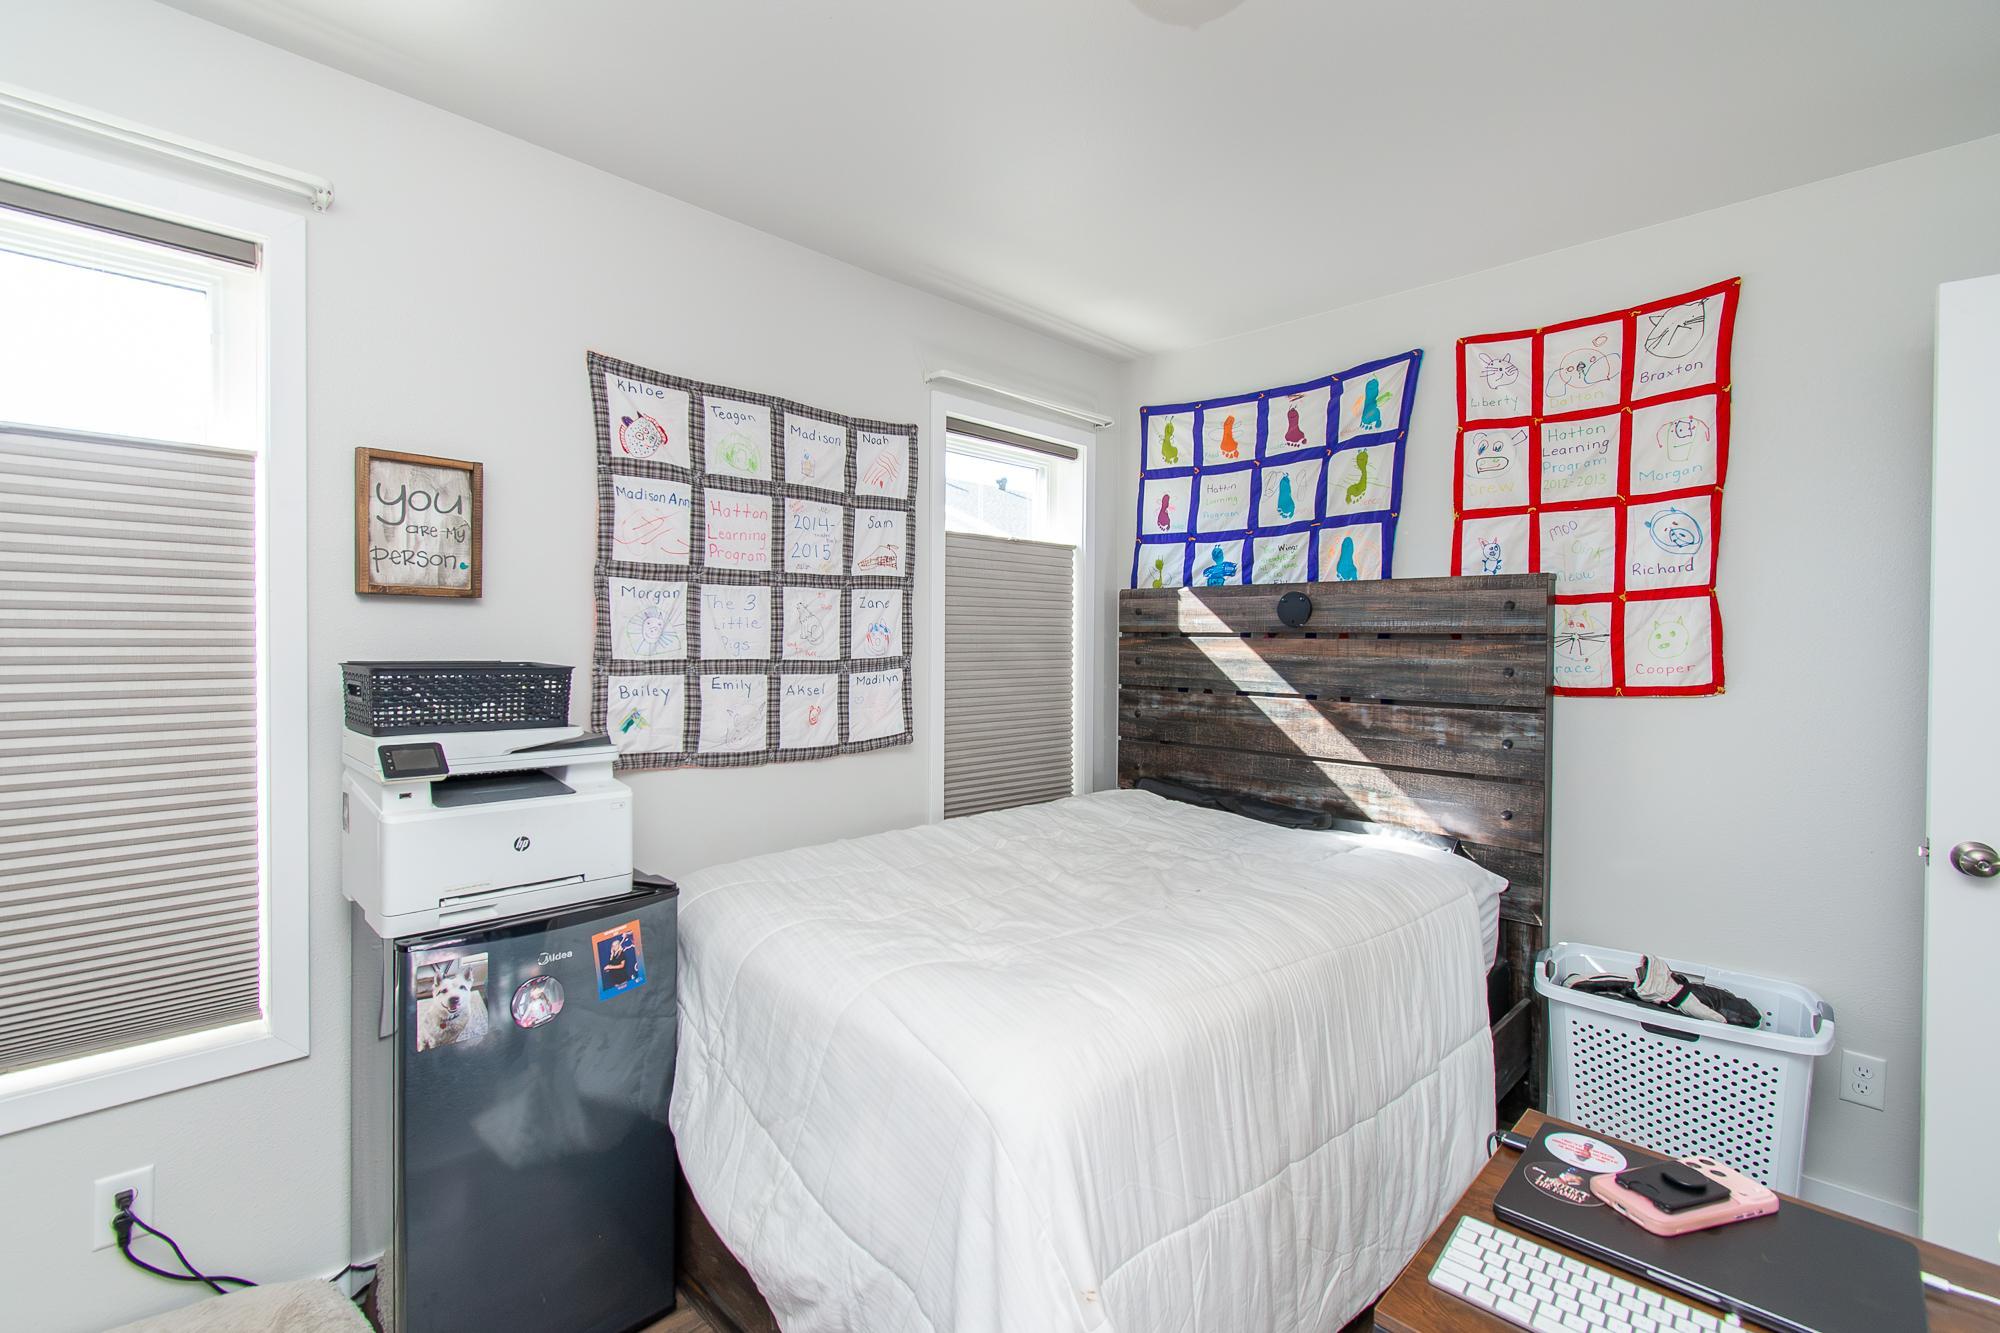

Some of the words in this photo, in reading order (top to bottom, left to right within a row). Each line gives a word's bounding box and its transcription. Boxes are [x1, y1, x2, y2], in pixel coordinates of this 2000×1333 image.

[1639, 360, 1704, 384] Braxton
[617, 379, 665, 400] Khloe
[1470, 395, 1519, 411] Liberty
[710, 405, 756, 424] Teagan
[790, 424, 842, 447] Madison
[862, 433, 889, 446] Noah
[1547, 424, 1606, 443] Hatton
[1542, 438, 1610, 458] Learning
[1543, 456, 1608, 477] Program
[1639, 463, 1704, 484] Morgan
[616, 486, 666, 504] Madison
[668, 493, 690, 508] Ann
[710, 501, 769, 520] Hatton
[868, 515, 893, 530] Sam
[707, 524, 767, 543] Learning
[709, 545, 767, 563] Program
[791, 542, 832, 562] 2015
[1632, 557, 1695, 576] Richard
[621, 585, 681, 604] Morgan
[703, 593, 734, 611] The
[743, 594, 756, 611] 3
[859, 597, 890, 610] Zane
[721, 636, 751, 656] Pigs
[1555, 663, 1595, 674] race
[1635, 663, 1696, 677] Cooper
[711, 677, 752, 698] Emily
[785, 683, 826, 697] Aksel
[856, 673, 899, 688] Madilyn
[619, 685, 671, 706] Bailey
[514, 836, 531, 852] hp
[538, 950, 573, 966] Midea
